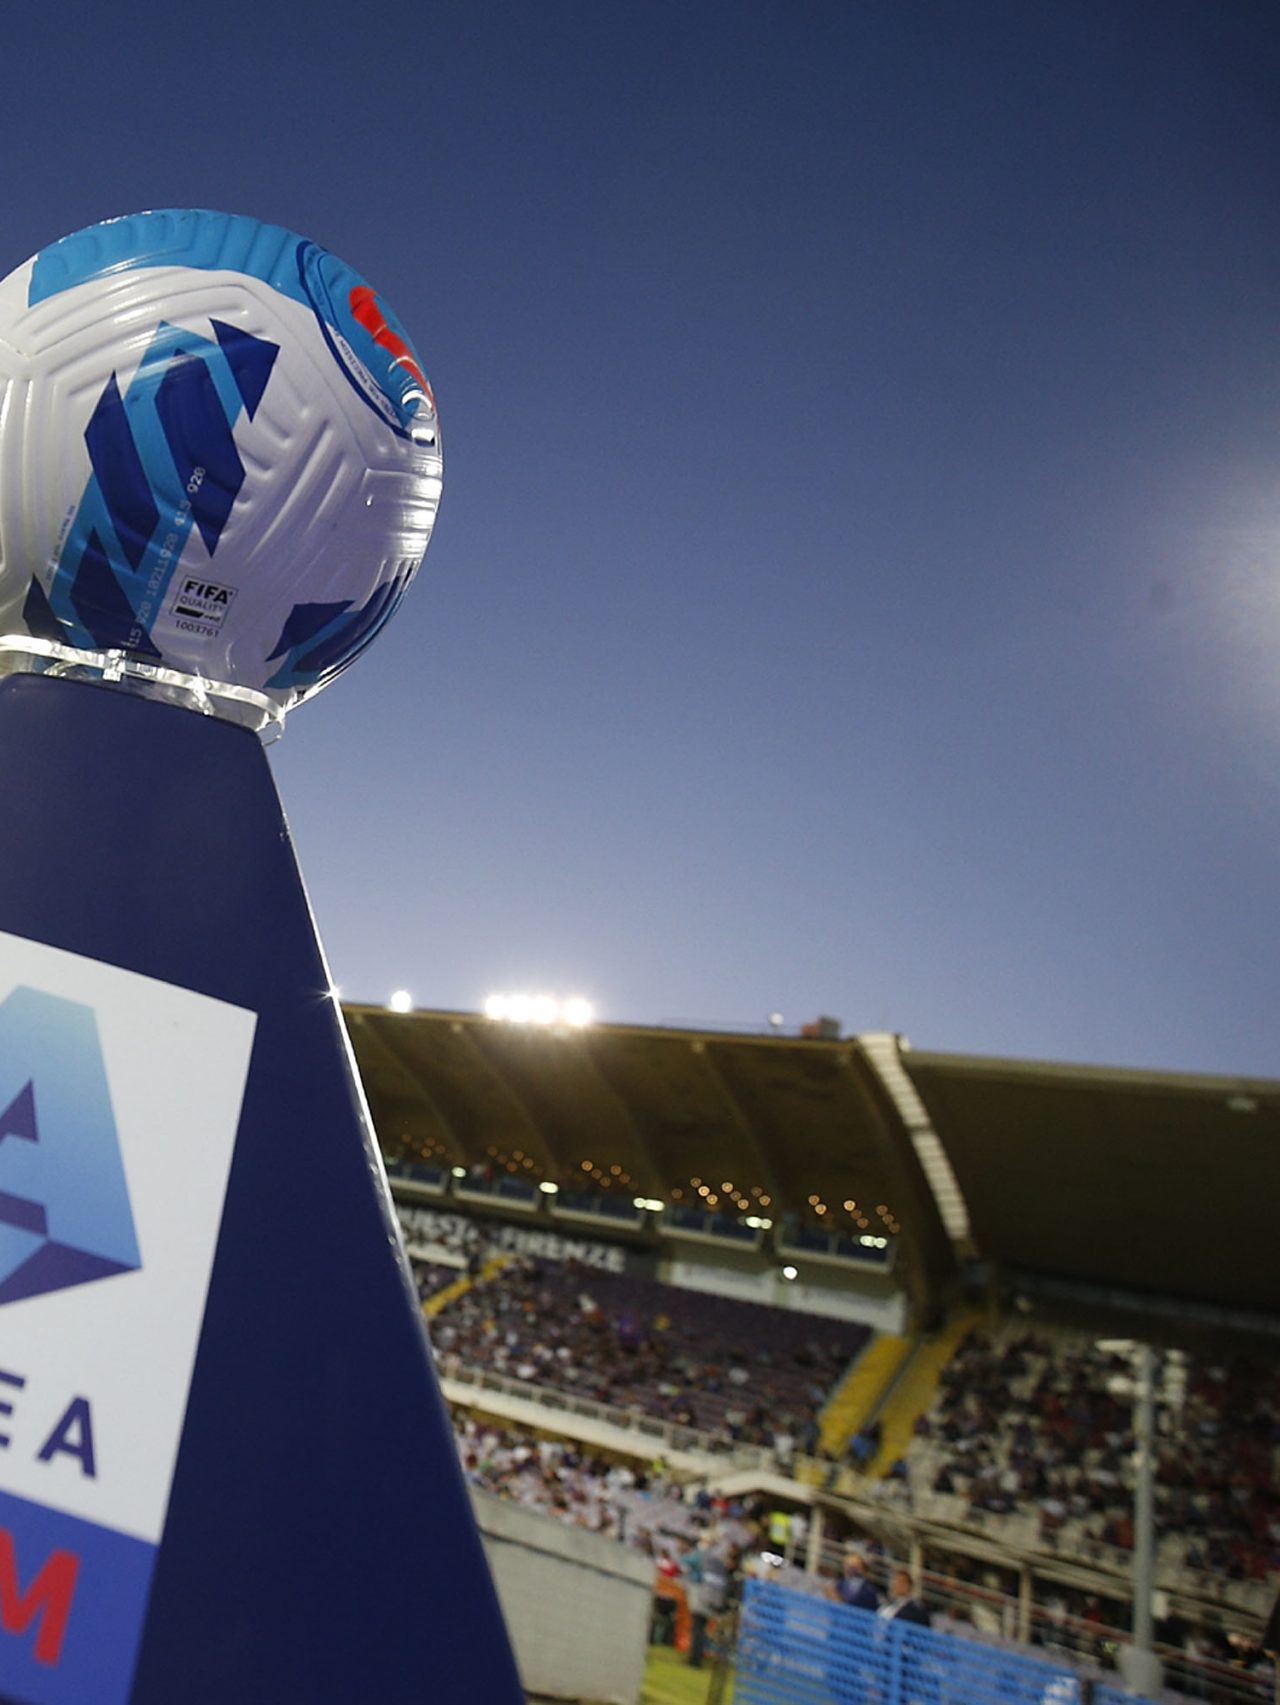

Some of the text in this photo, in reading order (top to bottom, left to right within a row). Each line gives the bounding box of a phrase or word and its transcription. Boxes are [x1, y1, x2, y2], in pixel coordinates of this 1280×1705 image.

[186, 466, 206, 493] 920
[180, 595, 226, 612] QUALITY
[184, 579, 228, 605] FIFA
[175, 620, 219, 637] 1003761
[35, 1393, 98, 1481] A
